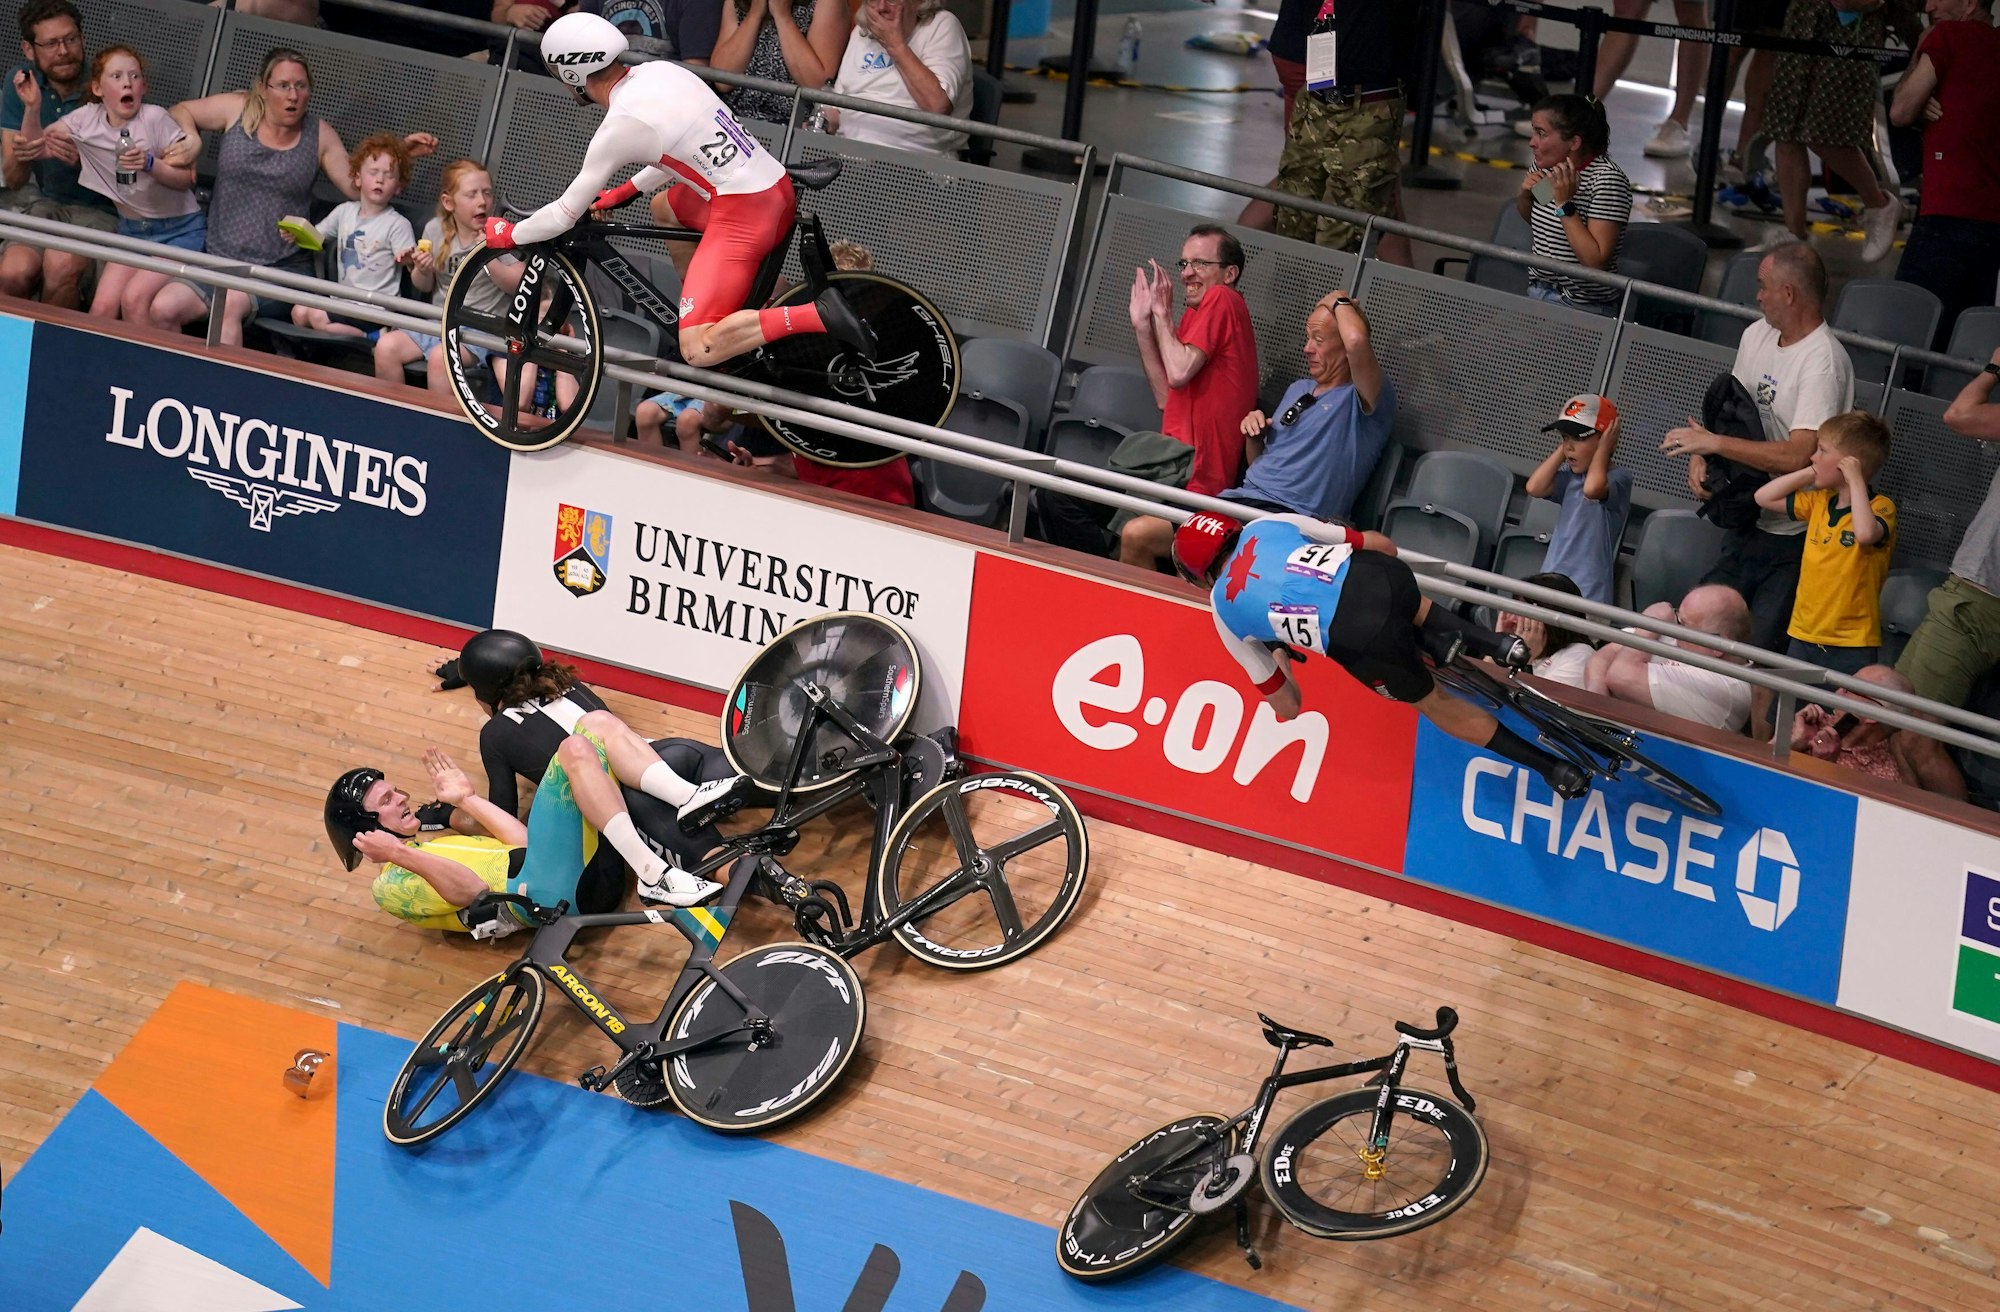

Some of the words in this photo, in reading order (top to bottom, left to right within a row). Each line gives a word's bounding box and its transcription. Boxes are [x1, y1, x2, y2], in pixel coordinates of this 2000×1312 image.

[1654, 24, 1715, 42] BIRMINGHAM
[1717, 32, 1741, 46] 2022
[547, 51, 607, 66] LAZER
[692, 154, 709, 171] CHASE
[700, 131, 738, 168] 29
[509, 254, 545, 325] LOTUS
[448, 327, 499, 429] CORIMA
[105, 386, 428, 517] LONGINES
[634, 521, 897, 613] UNIVERSITY
[886, 589, 920, 621] OF
[1299, 545, 1336, 567] 15
[626, 574, 806, 647] BIRMIN
[1281, 616, 1313, 648] 15
[959, 777, 1061, 816] CORIMA
[1462, 756, 1724, 903] CHASE
[903, 921, 1005, 958] CORIMA
[757, 951, 850, 1005] ZIPP
[549, 964, 611, 1025] ARGON
[603, 1014, 626, 1035] 18
[673, 981, 718, 1090] ZPP
[734, 1036, 841, 1117] ZIPP
[1396, 1094, 1448, 1121] EDGE
[1273, 1143, 1295, 1184] EDGE
[1385, 1193, 1444, 1220] EDGE
